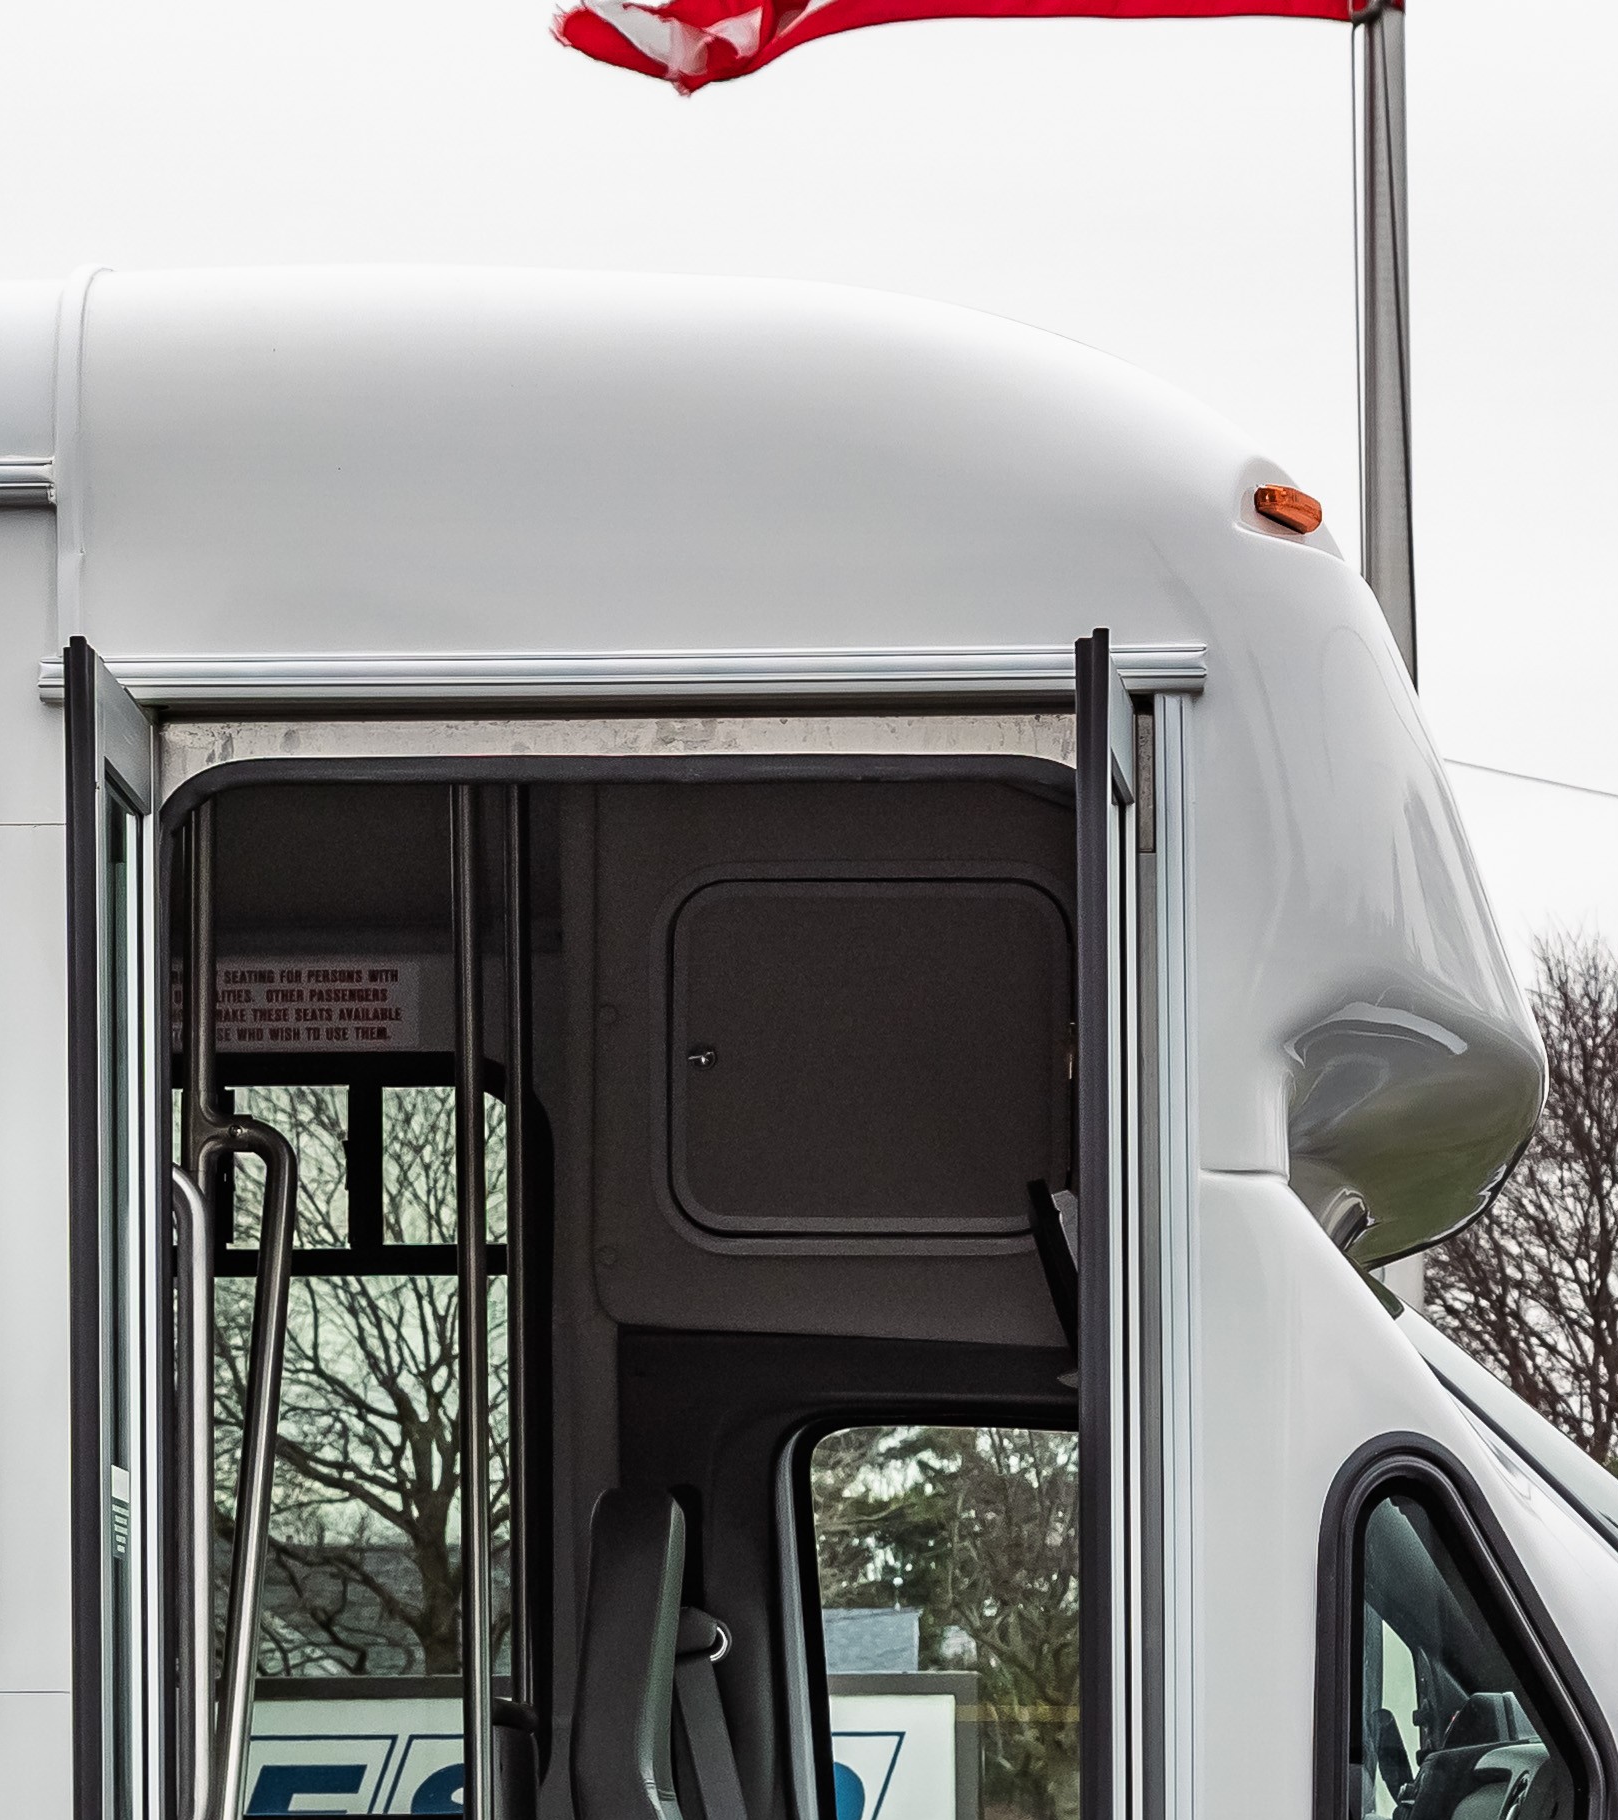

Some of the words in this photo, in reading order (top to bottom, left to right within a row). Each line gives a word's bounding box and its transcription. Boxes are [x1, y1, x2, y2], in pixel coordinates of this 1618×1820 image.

[223, 969, 275, 984] SEATING
[280, 969, 302, 983] FOR
[307, 969, 363, 983] PERSONS
[368, 969, 399, 983] WITH
[266, 988, 304, 1003] OTHER
[309, 988, 389, 1003] PASSENGERS
[252, 1008, 290, 1022] THESE
[295, 1008, 333, 1022] SEATS
[339, 1007, 402, 1022] AVAILABLE
[237, 1027, 264, 1041] WHO
[269, 1027, 301, 1041] WISH
[305, 1027, 321, 1041] TO
[326, 1027, 350, 1041] USE
[354, 1027, 391, 1041] THEM.
